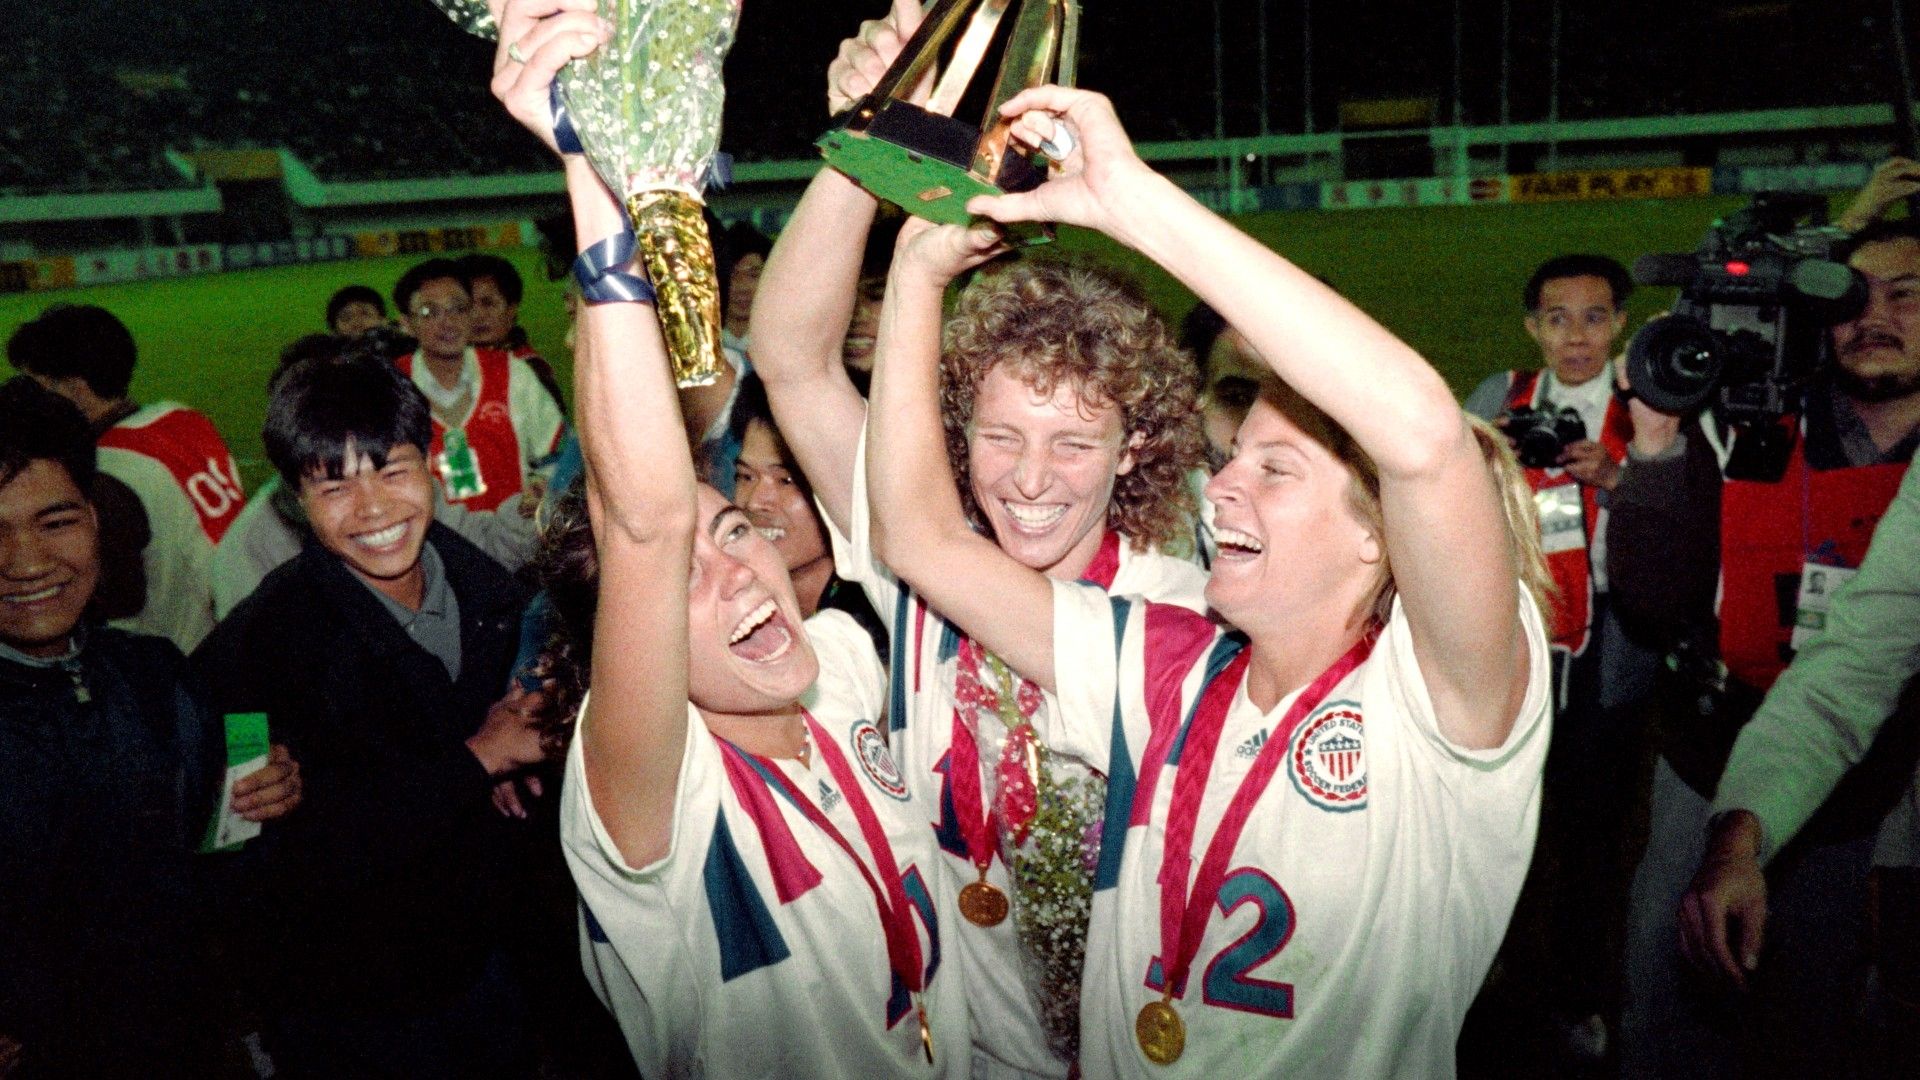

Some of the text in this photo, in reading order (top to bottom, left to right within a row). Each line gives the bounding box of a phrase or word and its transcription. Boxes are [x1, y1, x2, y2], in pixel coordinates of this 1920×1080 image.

[1309, 719, 1365, 746] UNITED STATE
[1304, 760, 1368, 793] SOCCER FEDERA
